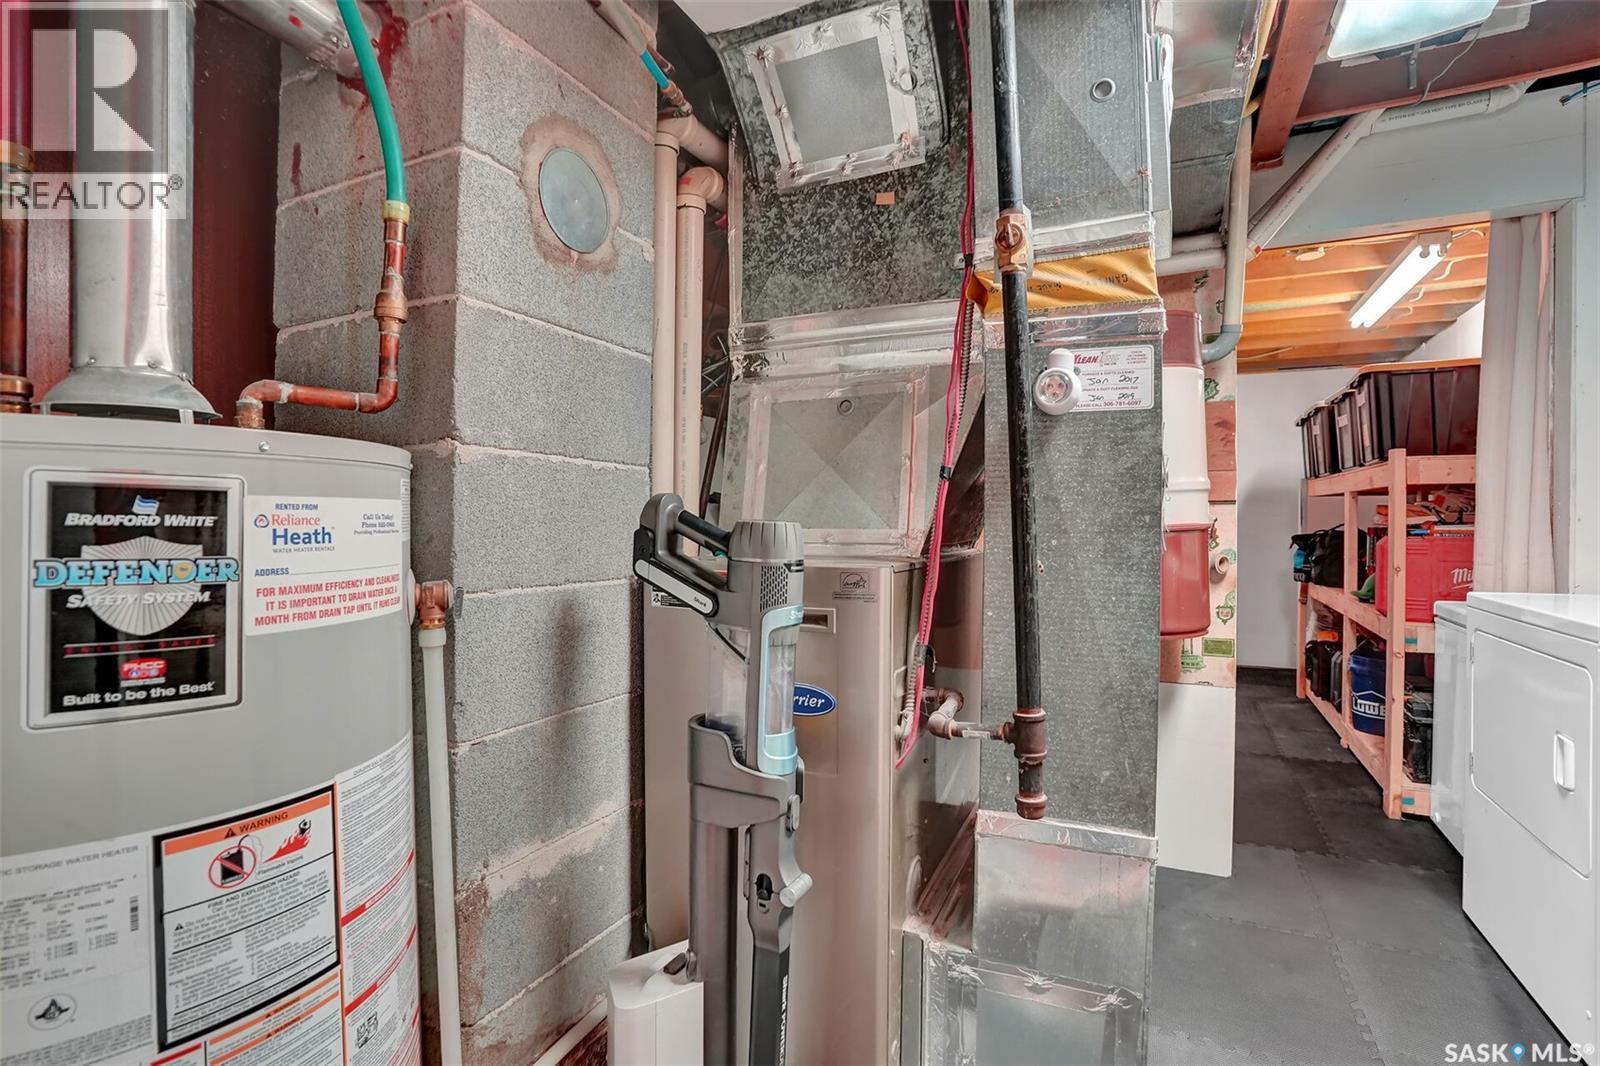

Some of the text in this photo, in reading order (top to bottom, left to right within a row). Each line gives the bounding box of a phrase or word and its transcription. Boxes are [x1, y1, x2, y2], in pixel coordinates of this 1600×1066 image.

[1118, 374, 1139, 384] 2017
[275, 503, 318, 511] RENTED FROM
[64, 512, 217, 527] BRADFORD WHITE
[271, 513, 321, 526] Reliance
[33, 557, 240, 588] DEFENDER
[254, 567, 290, 577] ADDRESS
[256, 587, 276, 598] FOR
[278, 583, 323, 596] MAXIMUM
[325, 578, 363, 592] EFFICIENCY
[364, 576, 375, 586] AND
[66, 590, 211, 609] SAFETY SYSTEM
[265, 601, 275, 611] IT
[278, 599, 287, 610] IS
[289, 594, 336, 609] IMPORTANT
[338, 594, 347, 603] TO
[348, 590, 367, 602] DRAIN
[367, 587, 384, 598] WATER
[254, 614, 290, 626] MONTH
[292, 610, 317, 623] FROM
[319, 606, 342, 619] DRAIN
[343, 604, 357, 616] TAP
[357, 602, 373, 613] UNTIL
[373, 600, 378, 610] IT
[62, 693, 102, 707] Built
[104, 692, 122, 703] to
[125, 689, 148, 701] be
[149, 687, 177, 699] the
[239, 811, 289, 834] WARNING
[15, 860, 63, 875] STORAGE
[65, 853, 100, 865] WATER
[101, 845, 139, 858] HEATER
[208, 899, 223, 909] FIRE
[226, 893, 240, 903] AND
[241, 881, 277, 898] EXPLOSION
